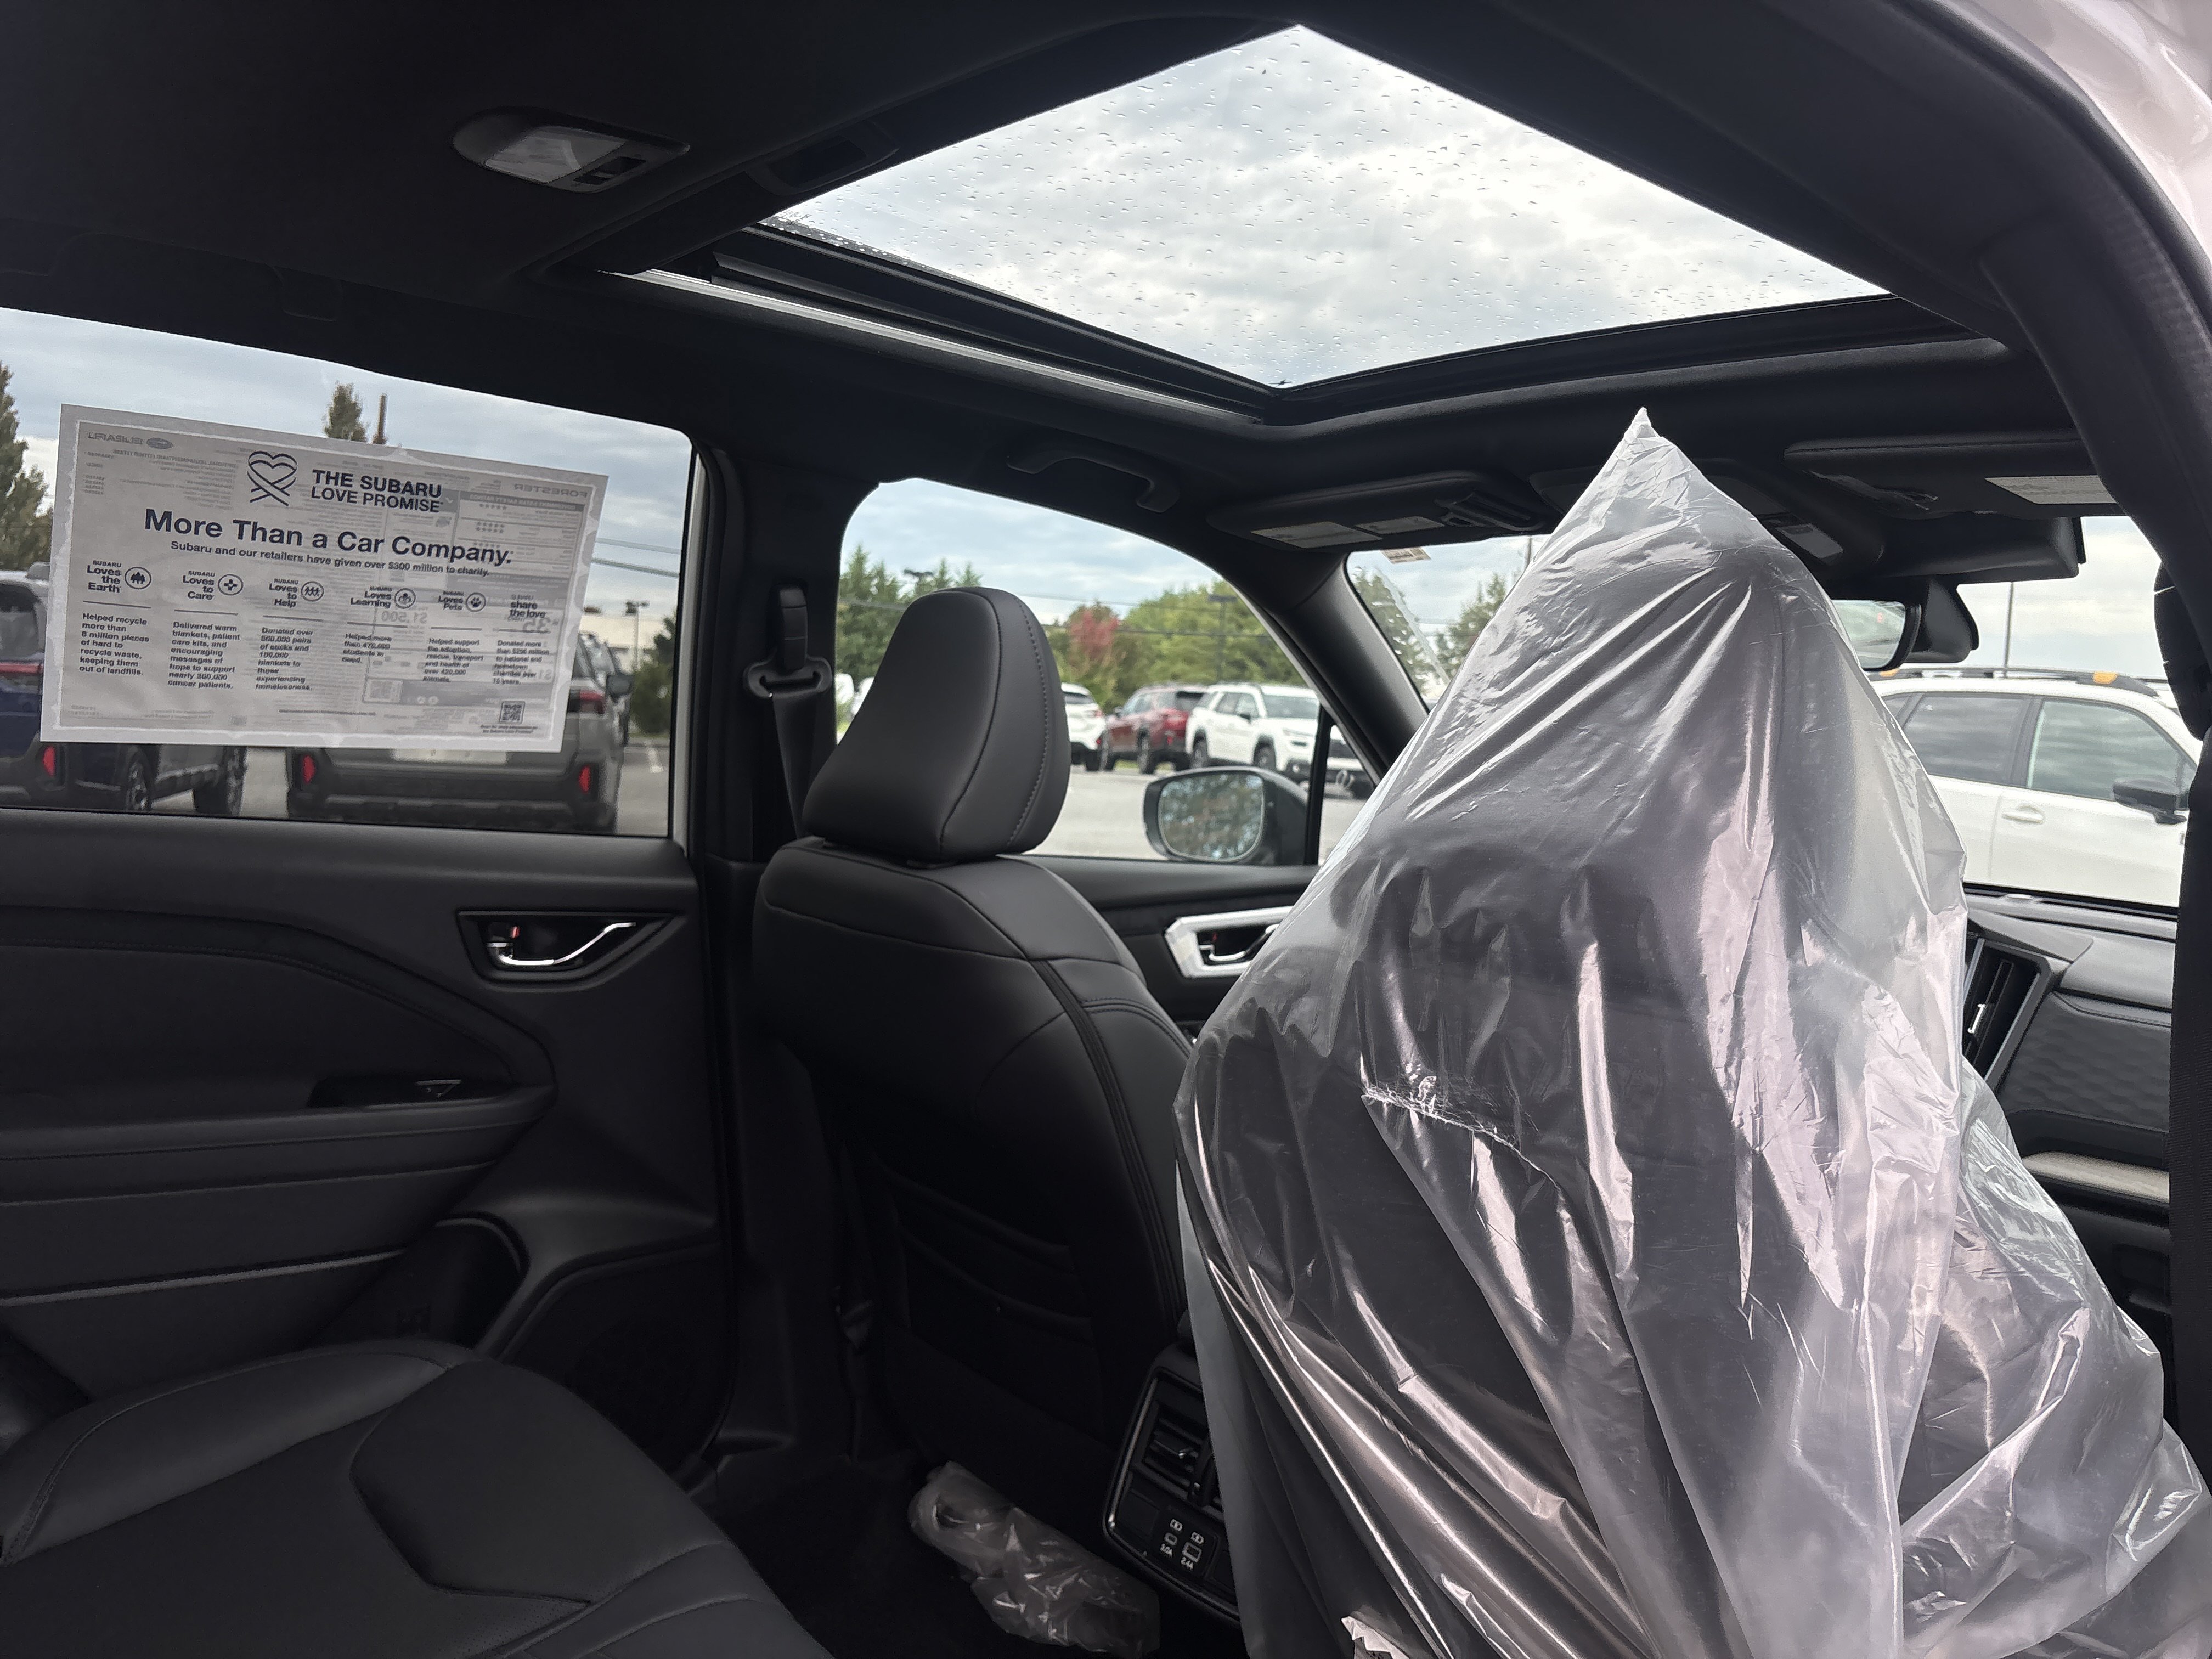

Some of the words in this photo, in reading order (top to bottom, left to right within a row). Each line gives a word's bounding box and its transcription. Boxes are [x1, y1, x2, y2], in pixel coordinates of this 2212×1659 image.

[312, 469, 354, 488] THE
[360, 475, 442, 498] SUBARU
[311, 486, 358, 504] LOVE
[363, 492, 440, 513] PROMISE
[144, 509, 223, 538] More
[232, 519, 303, 546] Than
[312, 532, 328, 549] a
[337, 531, 385, 554] Car
[392, 535, 511, 567] Company.
[171, 540, 212, 554] Subaru
[215, 546, 236, 556] and
[239, 549, 257, 557] our
[260, 551, 303, 562] retailers
[307, 555, 332, 565] have
[334, 558, 362, 568] given
[364, 561, 386, 569] over
[388, 561, 410, 571] $300
[413, 563, 444, 573] million
[446, 566, 455, 574] to
[87, 565, 121, 576] Loves
[101, 575, 120, 584] the
[182, 575, 215, 585] Loves
[88, 582, 120, 593] Earth
[268, 583, 298, 593] Loves
[187, 591, 213, 600] Care
[364, 590, 392, 600] Loves
[438, 595, 464, 604] Loves
[274, 598, 297, 608] Help
[351, 597, 391, 609] Learning
[510, 601, 538, 610] share
[510, 608, 526, 617] the
[527, 609, 546, 619] love
[83, 613, 114, 623] Helped
[116, 616, 148, 625] recycle
[107, 624, 127, 632] than
[173, 620, 213, 630] Delivered
[89, 631, 119, 640] million
[261, 627, 295, 635] Donated
[212, 633, 241, 641] patient
[345, 632, 372, 641] Helped
[80, 648, 112, 657] recycle
[170, 647, 223, 657] encouraging
[342, 648, 375, 657] students
[80, 656, 115, 667] keeping
[116, 659, 139, 667] them
[170, 656, 212, 664] messages
[107, 667, 143, 676] landfills.
[170, 663, 191, 672] hope
[168, 672, 195, 680] nearly
[256, 675, 306, 684] experiencing
